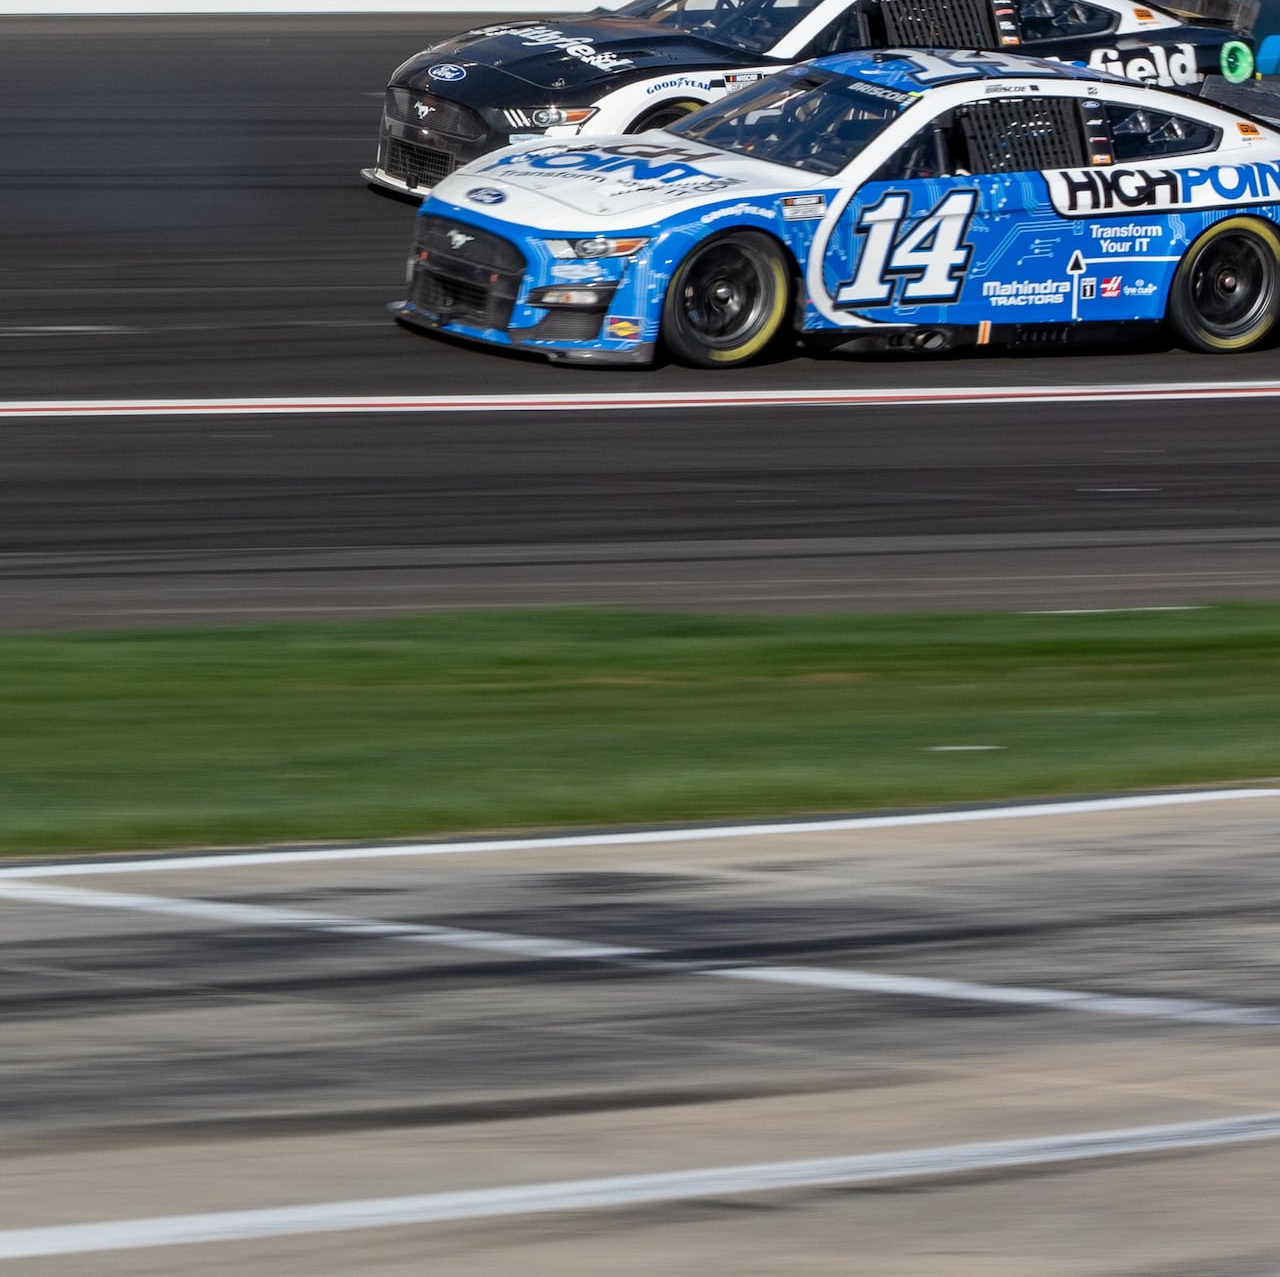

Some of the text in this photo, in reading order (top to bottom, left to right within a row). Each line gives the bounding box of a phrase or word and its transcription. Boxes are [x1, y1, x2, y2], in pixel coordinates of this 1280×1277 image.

[646, 77, 713, 95] GOODYEAR
[848, 82, 907, 103] BRISCOE
[1090, 223, 1163, 238] Transform
[832, 187, 980, 312] 14
[1100, 237, 1151, 253] Your IT
[982, 279, 1071, 297] Mahindra
[989, 294, 1064, 307] TRACTORS
